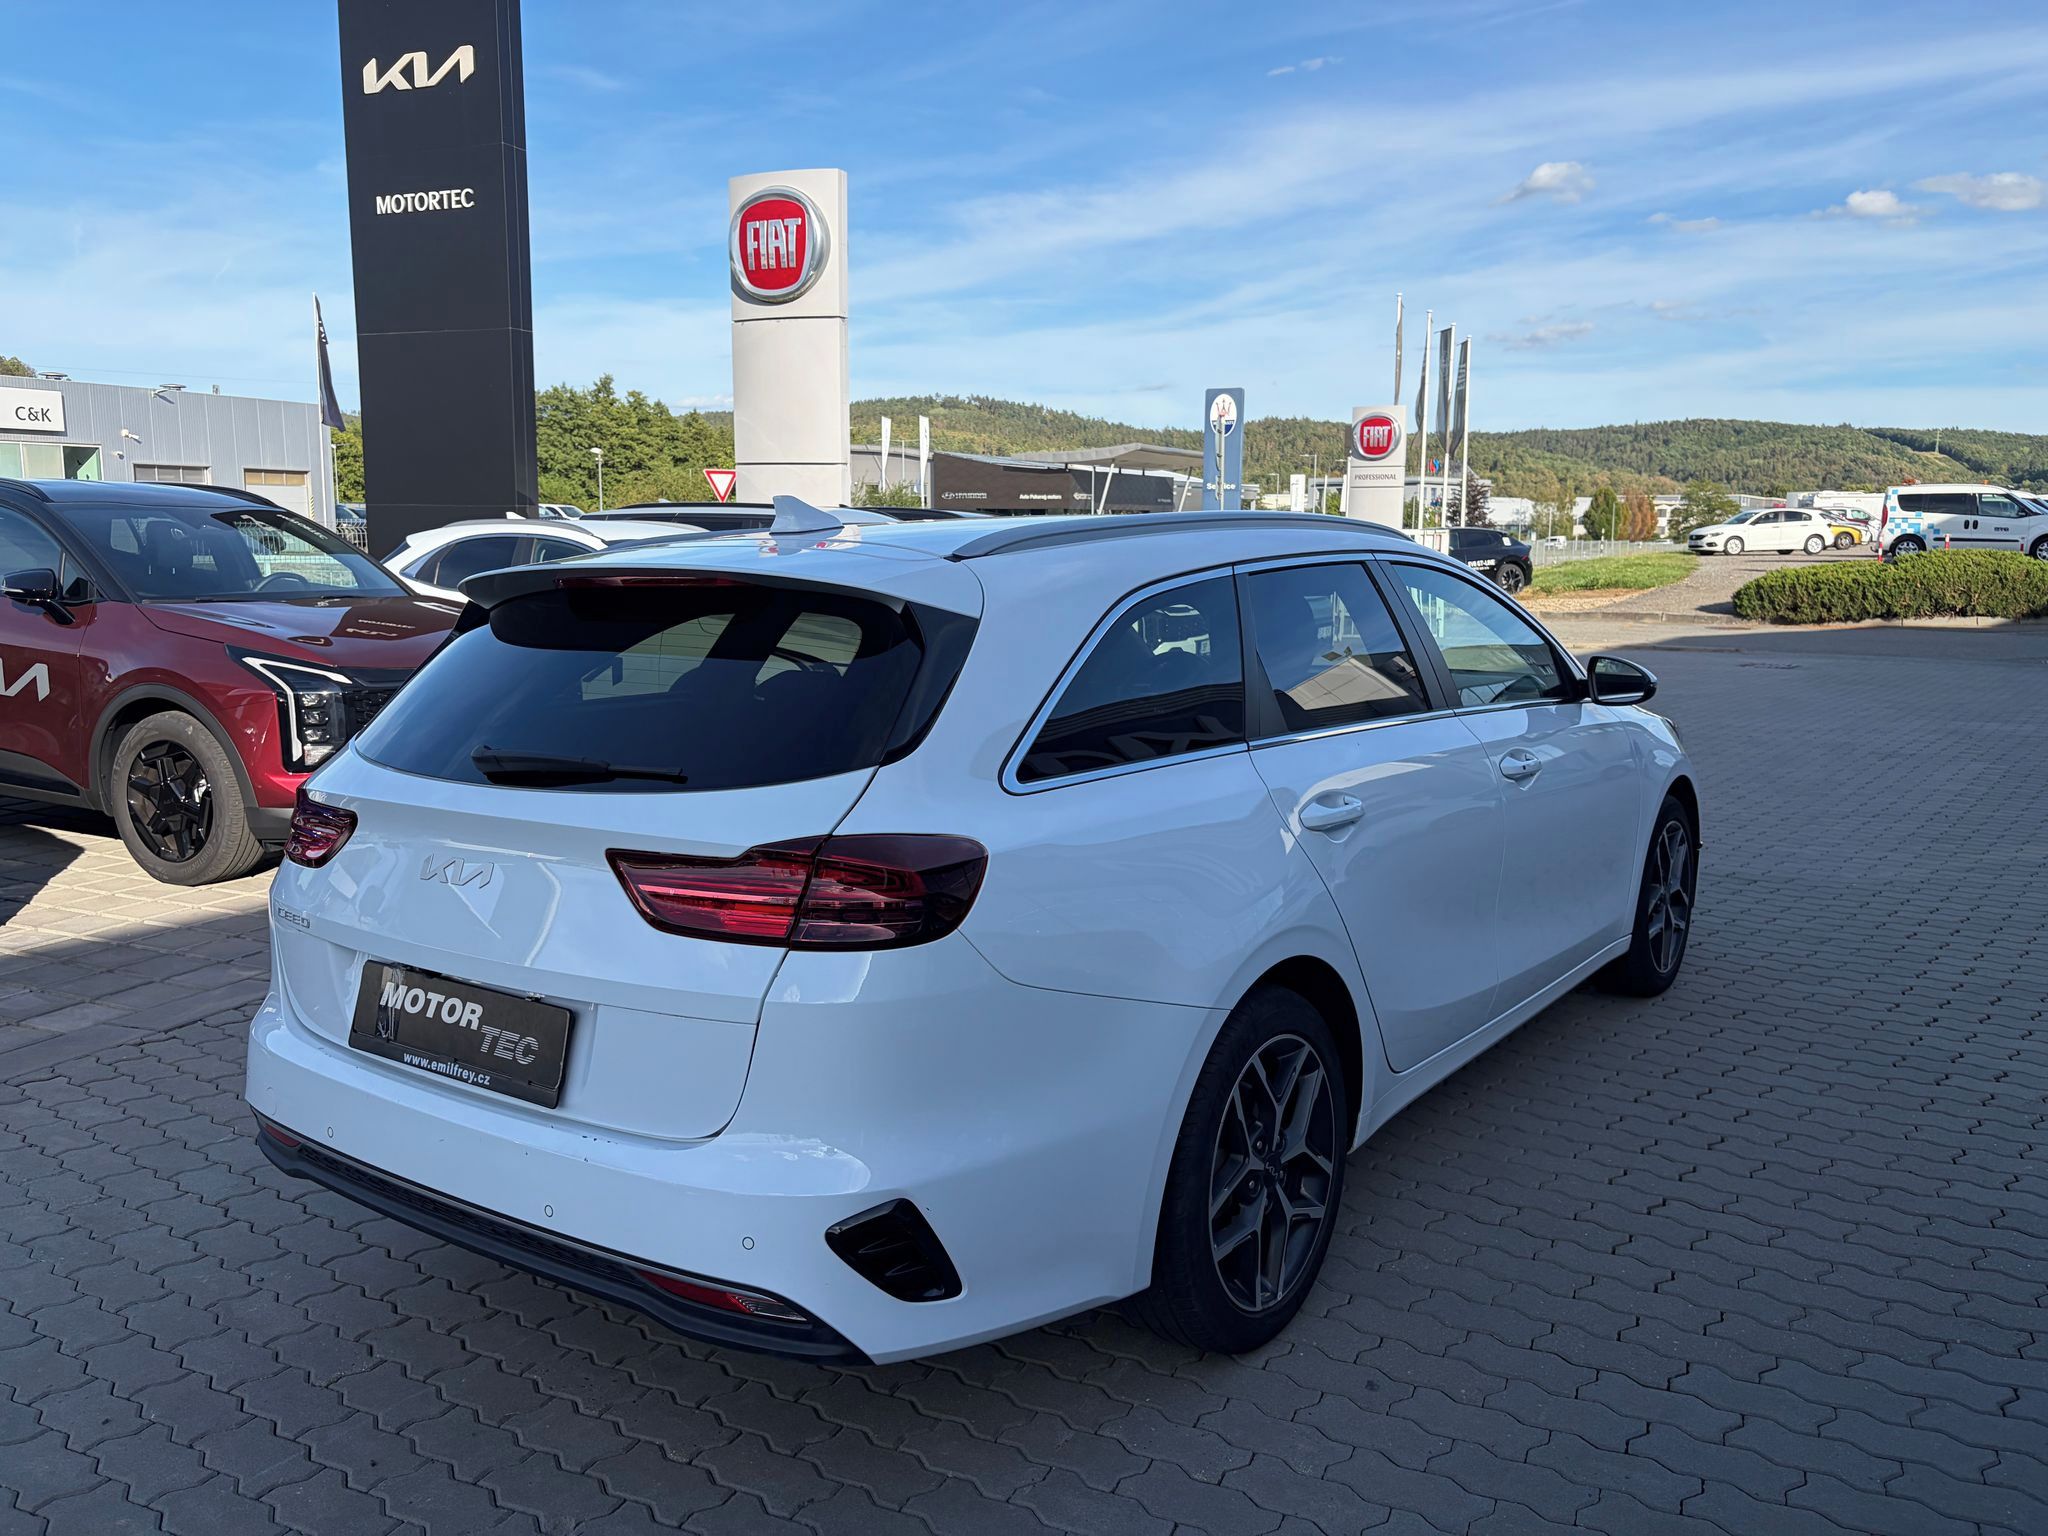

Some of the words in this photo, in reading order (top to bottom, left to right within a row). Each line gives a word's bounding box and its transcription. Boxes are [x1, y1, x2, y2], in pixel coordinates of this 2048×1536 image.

[362, 44, 475, 95] KIA
[375, 187, 475, 215] MOTORTEC
[746, 217, 801, 271] FIAT
[15, 406, 52, 422] C&K
[1364, 426, 1391, 447] FIAT
[1354, 473, 1397, 481] PROFESSIONAL
[420, 853, 495, 889] KIA
[380, 981, 484, 1031] MOTOR
[480, 1025, 539, 1065] TEC
[403, 1053, 491, 1086] www.emilfrey.cz
